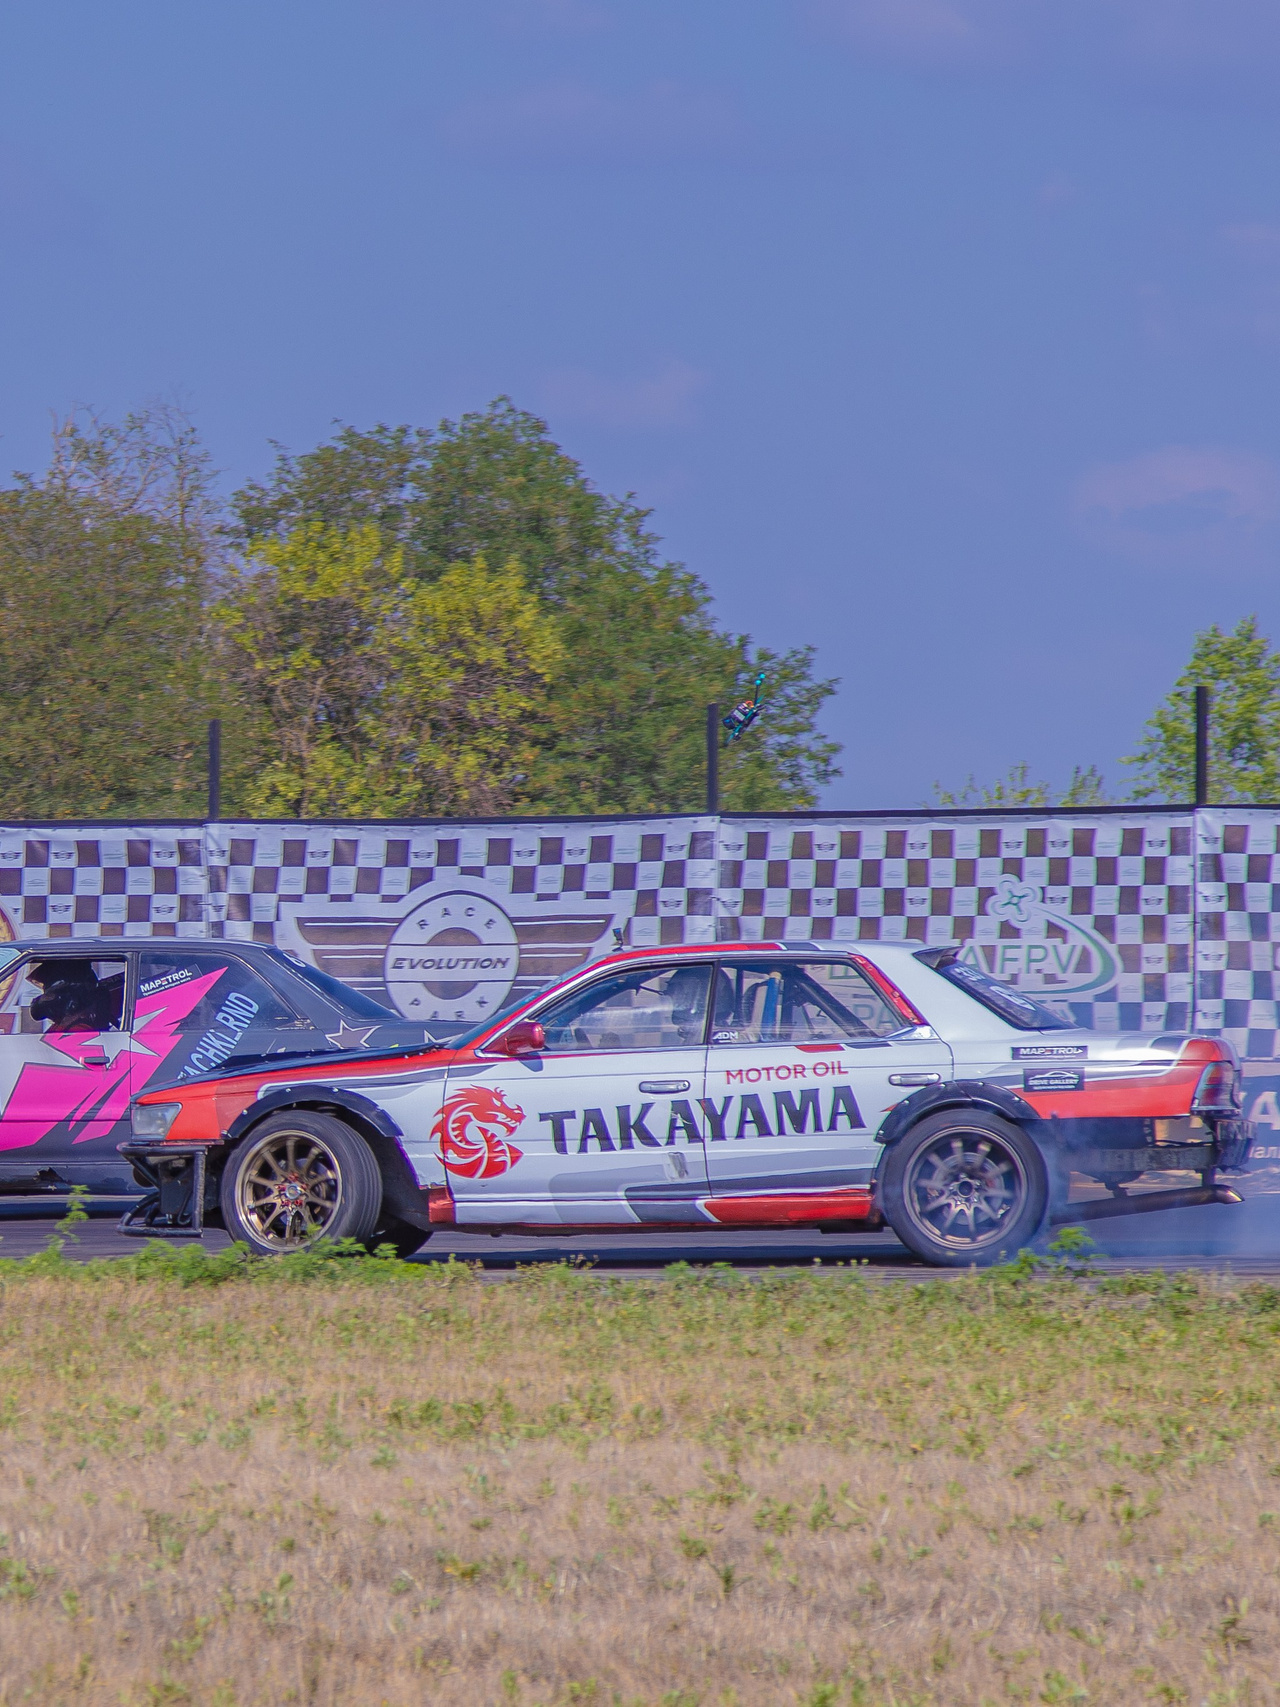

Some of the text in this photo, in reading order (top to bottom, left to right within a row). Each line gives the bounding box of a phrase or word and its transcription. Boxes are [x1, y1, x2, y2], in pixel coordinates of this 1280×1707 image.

[416, 906, 497, 930] RACE
[390, 957, 511, 970] EVOLUTION
[139, 968, 193, 993] MAPETROL
[725, 1060, 849, 1085] MOTOR OIL
[538, 1085, 868, 1155] TAKAYAMA
